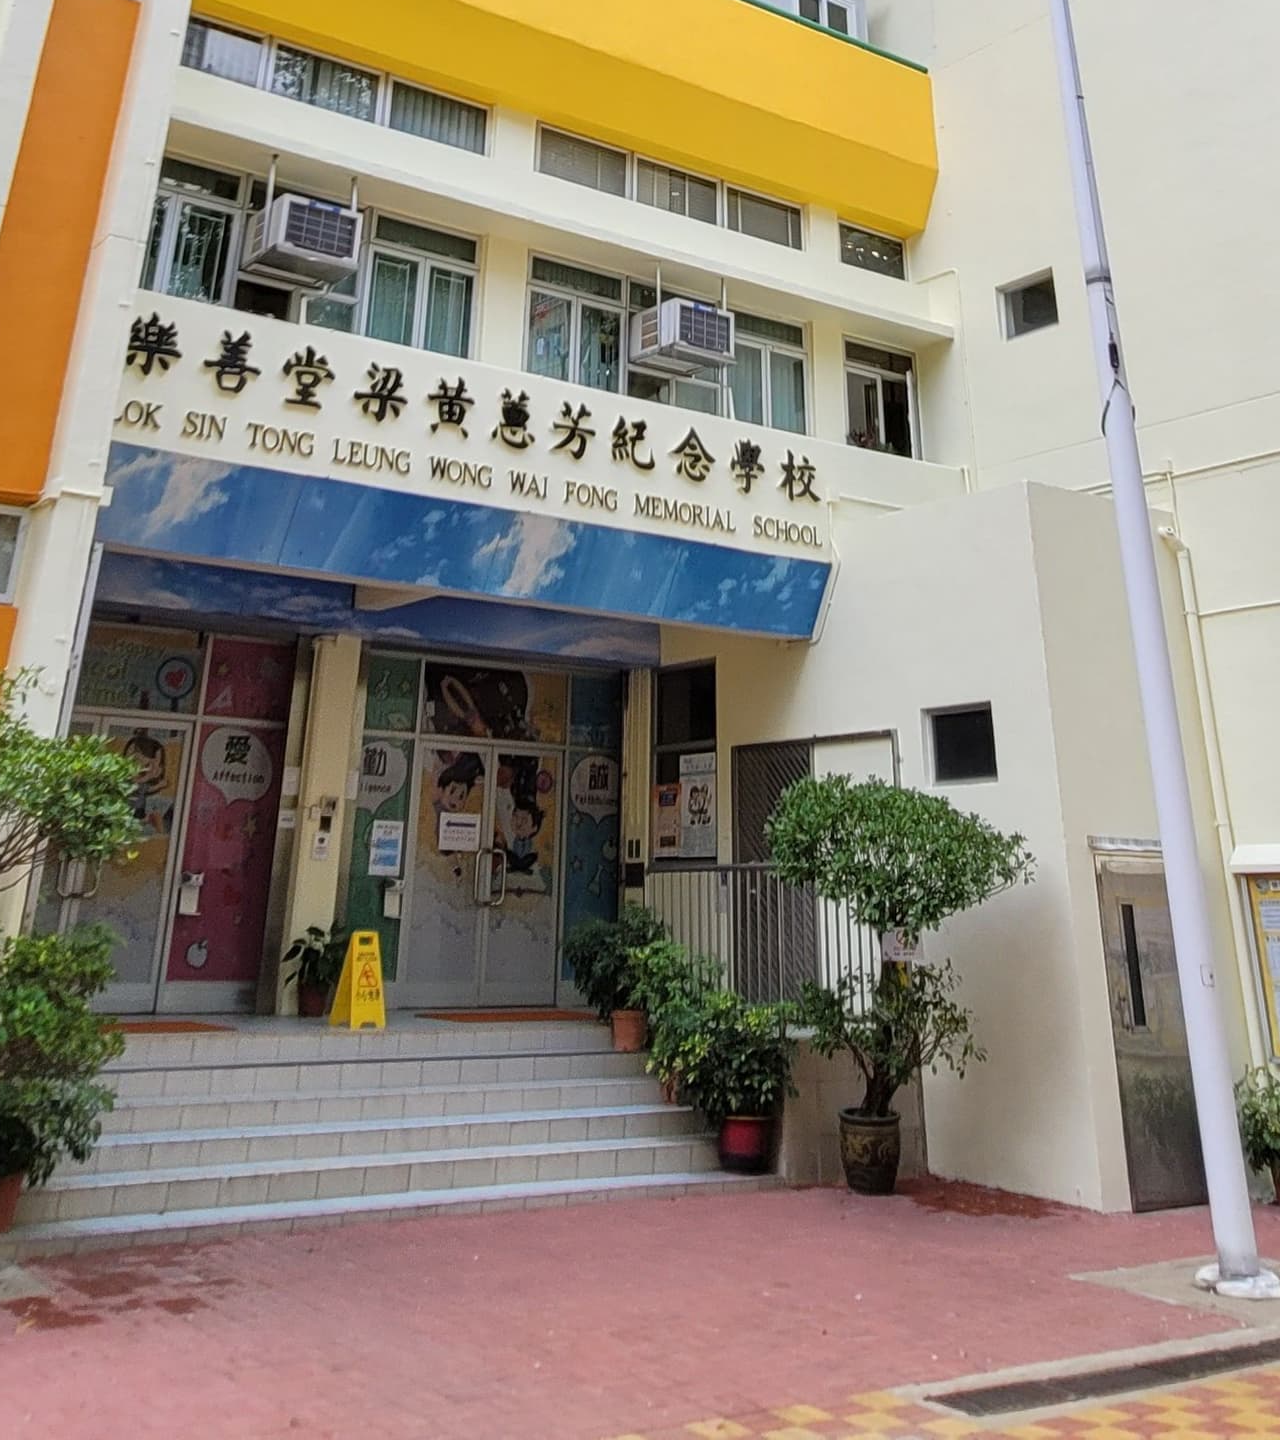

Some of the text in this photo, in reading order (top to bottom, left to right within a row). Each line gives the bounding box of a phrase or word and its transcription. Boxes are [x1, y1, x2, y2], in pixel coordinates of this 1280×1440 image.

[114, 399, 824, 548] OK SIN TONG LEUNG WONG WAI FONG MEMORIAL SCHOOL
